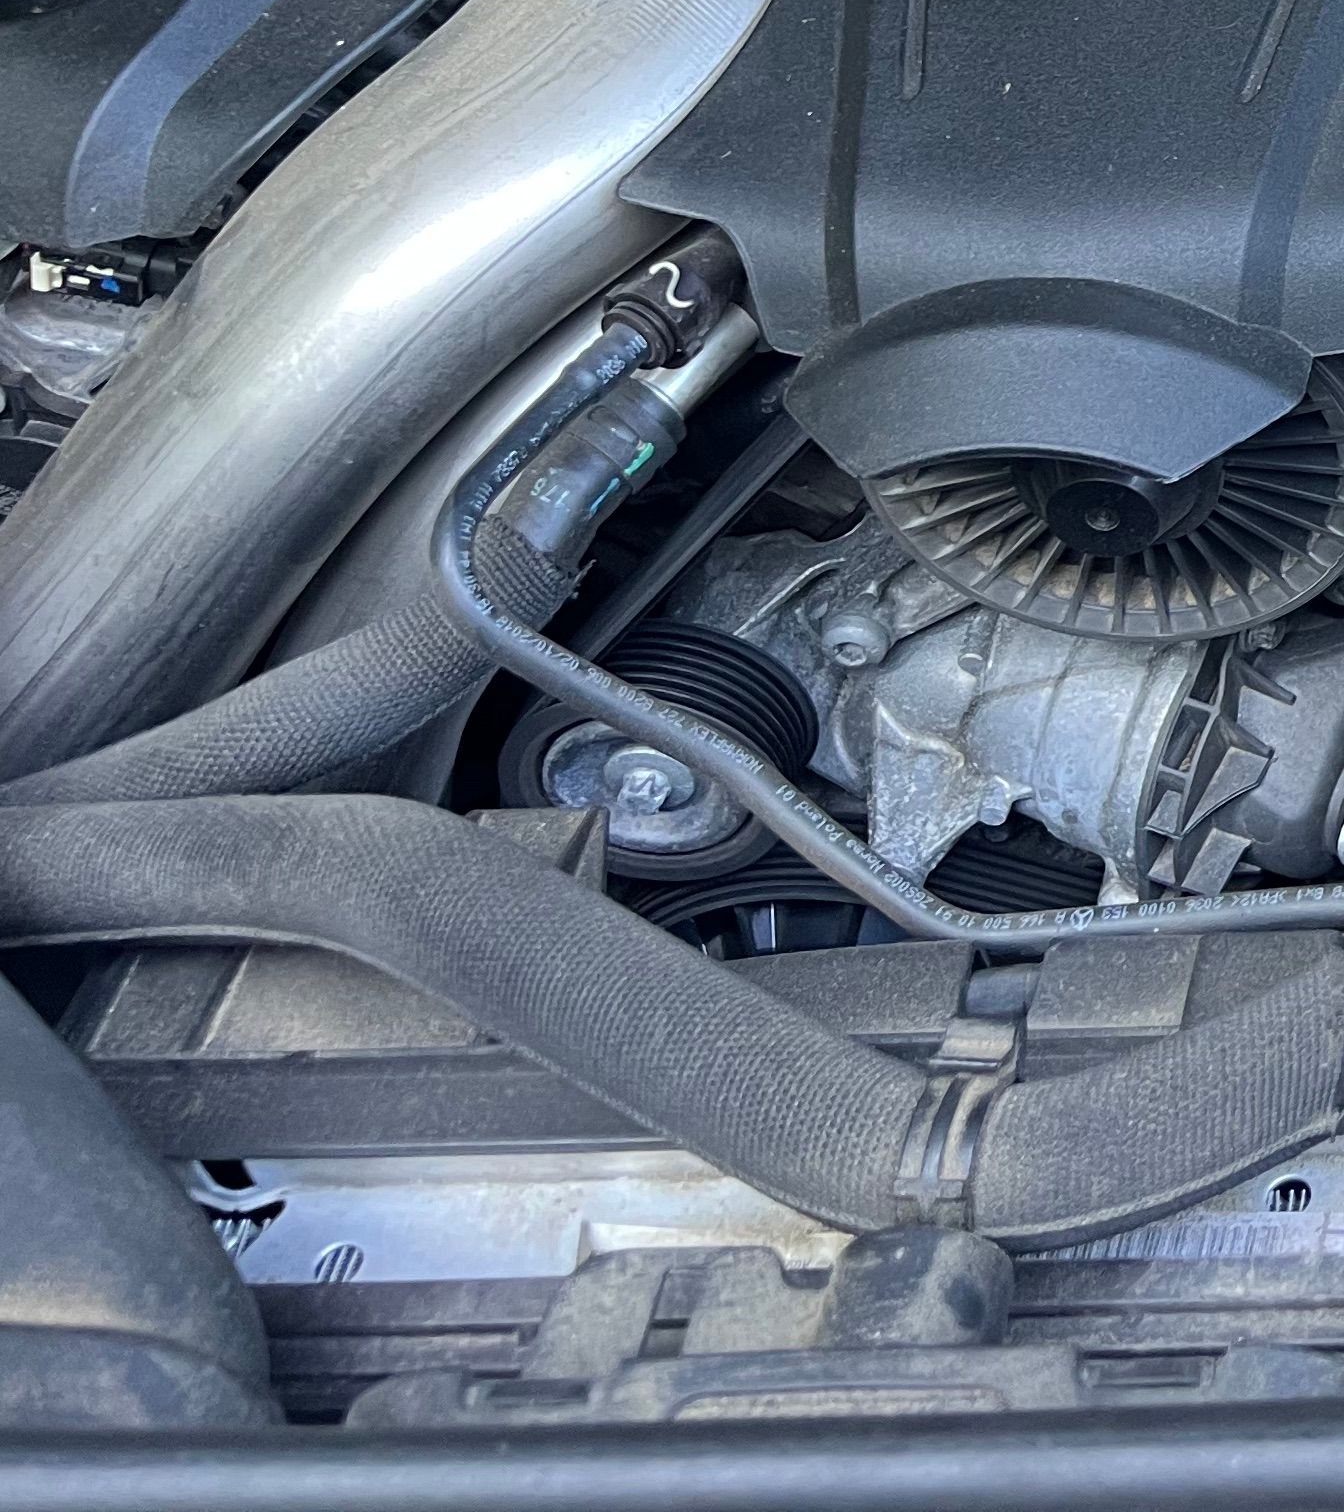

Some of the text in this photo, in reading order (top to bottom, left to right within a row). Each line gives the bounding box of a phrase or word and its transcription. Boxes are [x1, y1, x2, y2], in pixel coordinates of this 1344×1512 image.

[688, 721, 765, 776] NORMAFLEX
[791, 798, 846, 843] Poland
[840, 836, 887, 876] Norma
[959, 913, 976, 928] 10
[983, 915, 1012, 931] 500
[1018, 910, 1045, 927] 166
